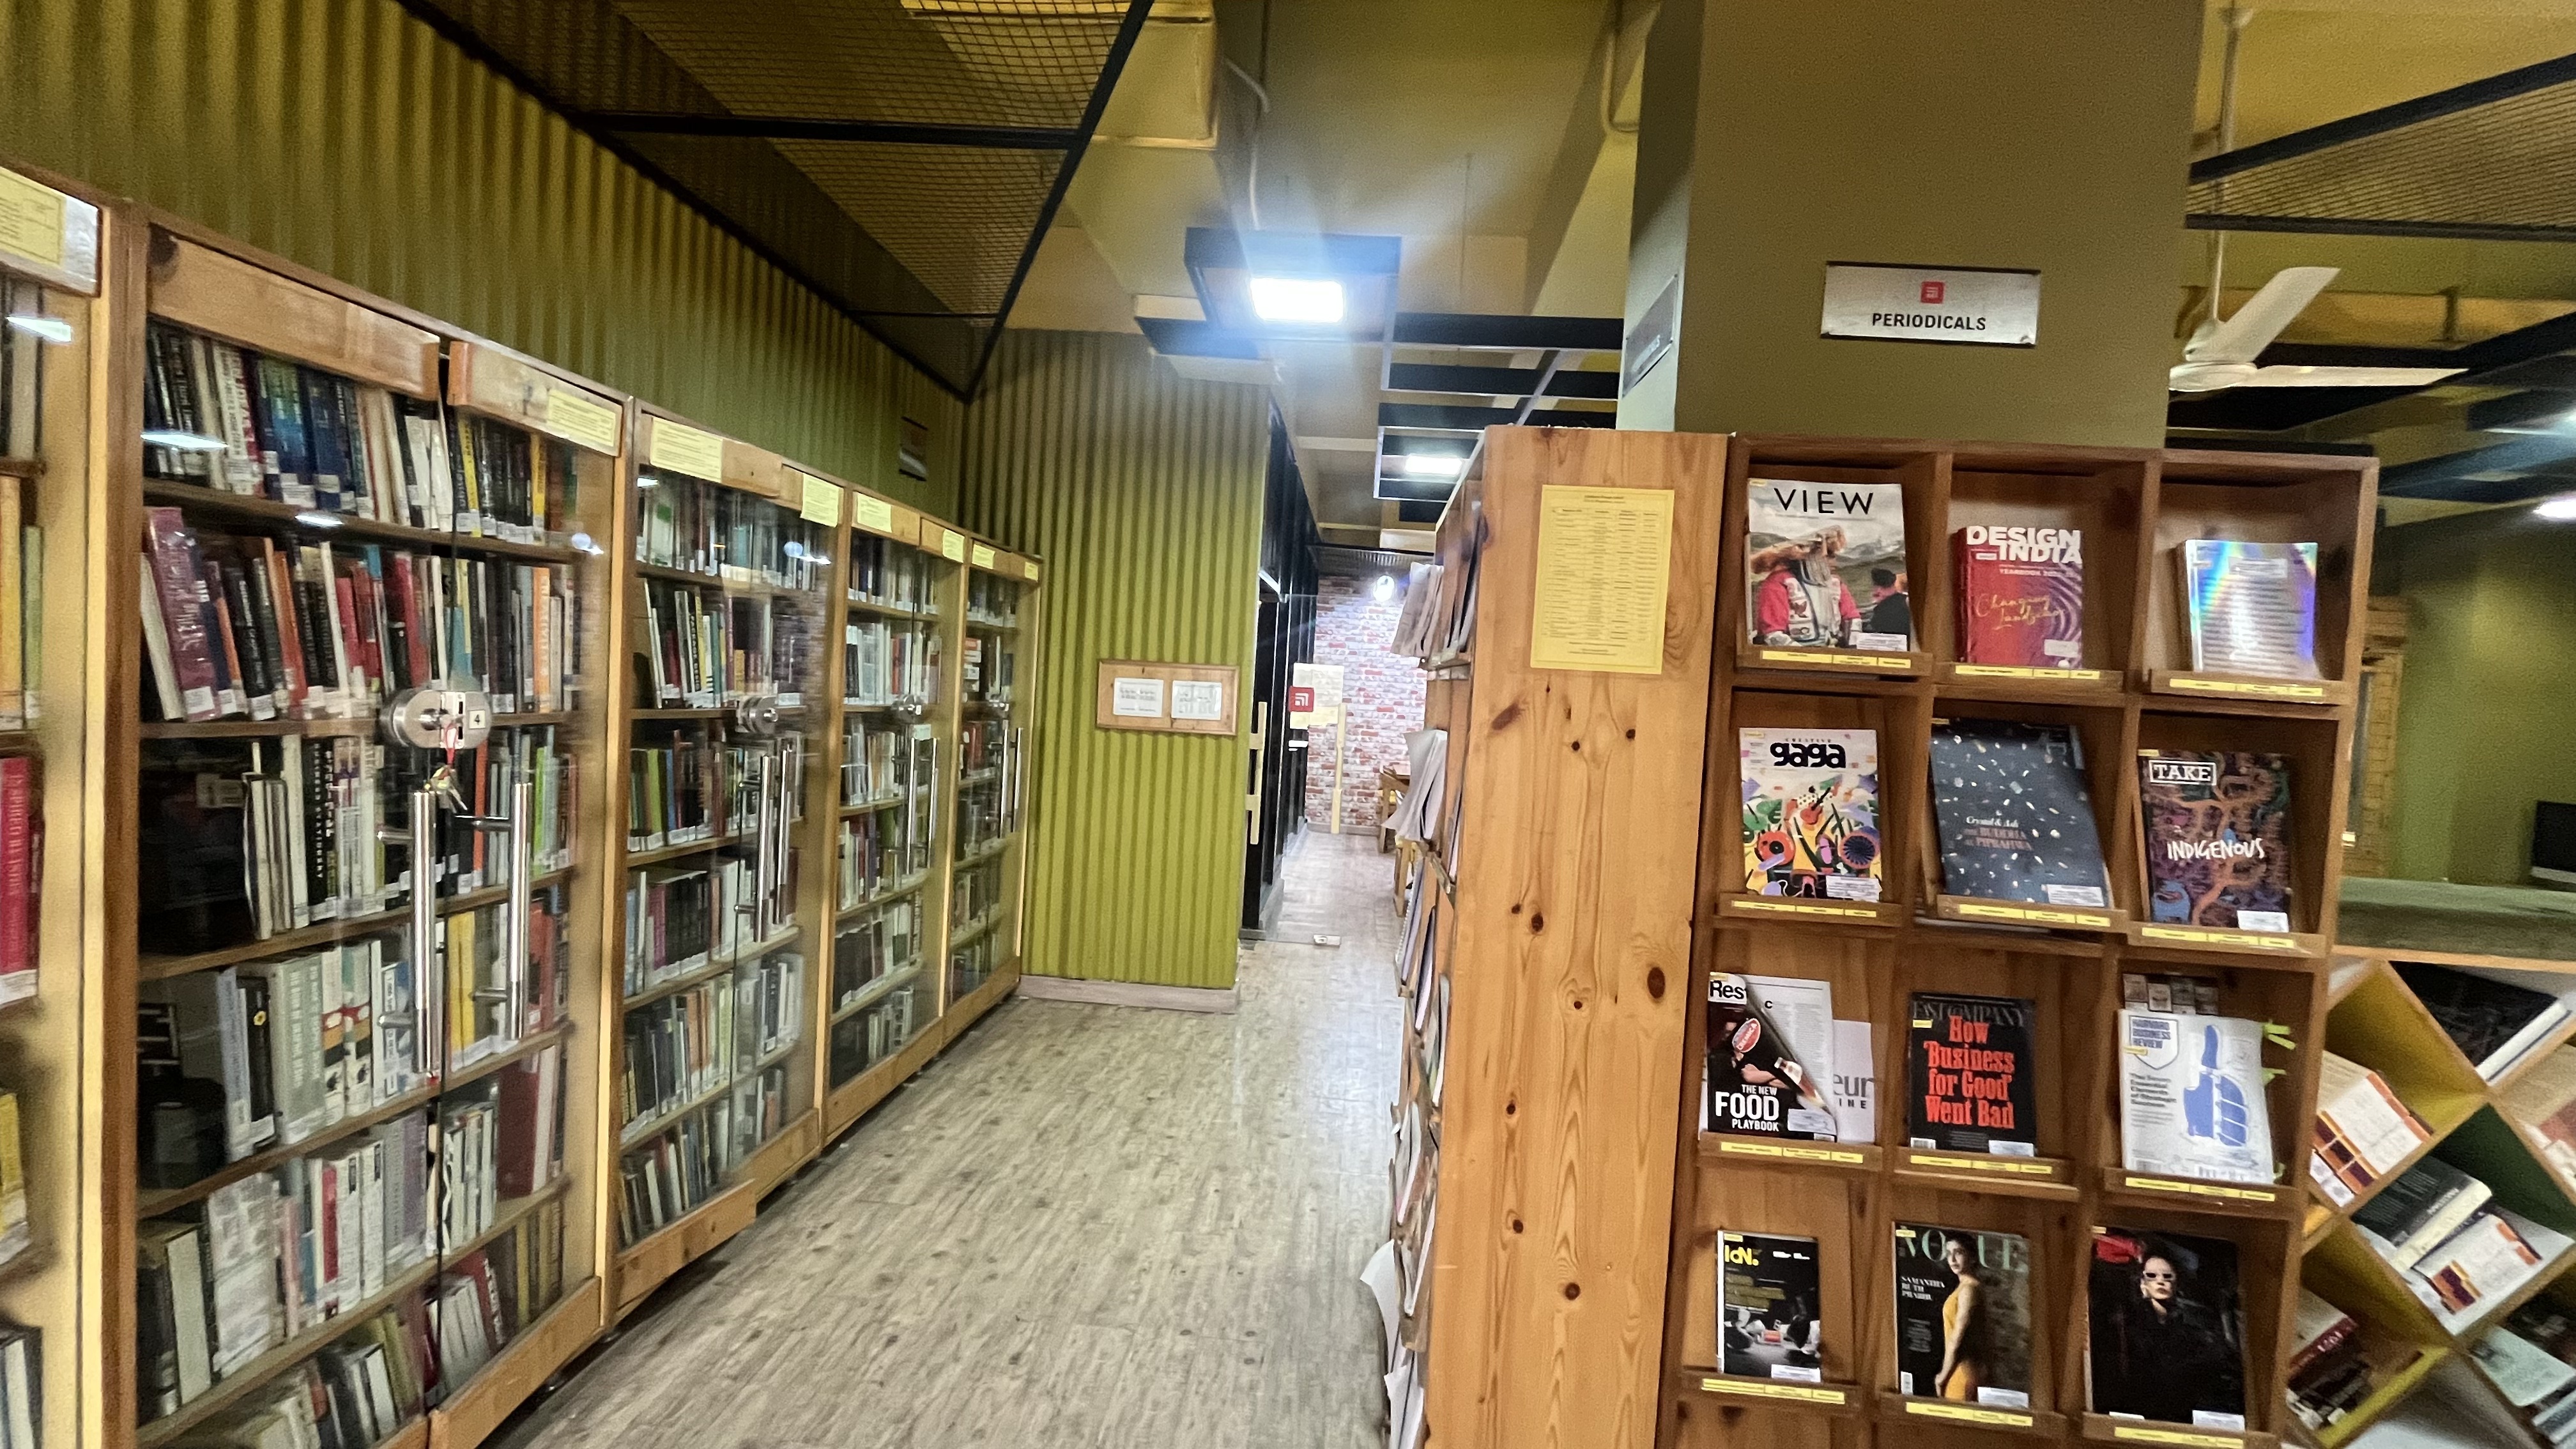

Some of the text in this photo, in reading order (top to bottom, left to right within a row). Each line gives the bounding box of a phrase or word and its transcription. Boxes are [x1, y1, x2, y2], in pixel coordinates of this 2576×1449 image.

[1872, 312, 1987, 331] PERIODICALS
[1774, 487, 1874, 515] VIEW
[1966, 526, 2082, 549] DESIGN
[1998, 543, 2083, 564] INDIA
[474, 714, 480, 725] 4
[1770, 742, 1846, 769] gaga
[2154, 763, 2211, 782] TAKE
[2166, 838, 2266, 861] INDIGENOUS
[1709, 979, 1747, 1000] Res
[1949, 1015, 1990, 1045] How
[1923, 1041, 2016, 1074] Business
[1742, 1084, 1777, 1096] THE NEW
[1928, 1068, 2013, 1101] for Good
[1715, 1091, 1780, 1121] FOOD
[1925, 1095, 2016, 1130] Went Bad
[1731, 1119, 1779, 1131] PLAYBOOK
[1900, 1225, 2029, 1273] VOUE
[1901, 1276, 1946, 1289] SAMANTHA
[1901, 1283, 1925, 1293] RUTH
[1901, 1290, 1933, 1301] PRABHU
